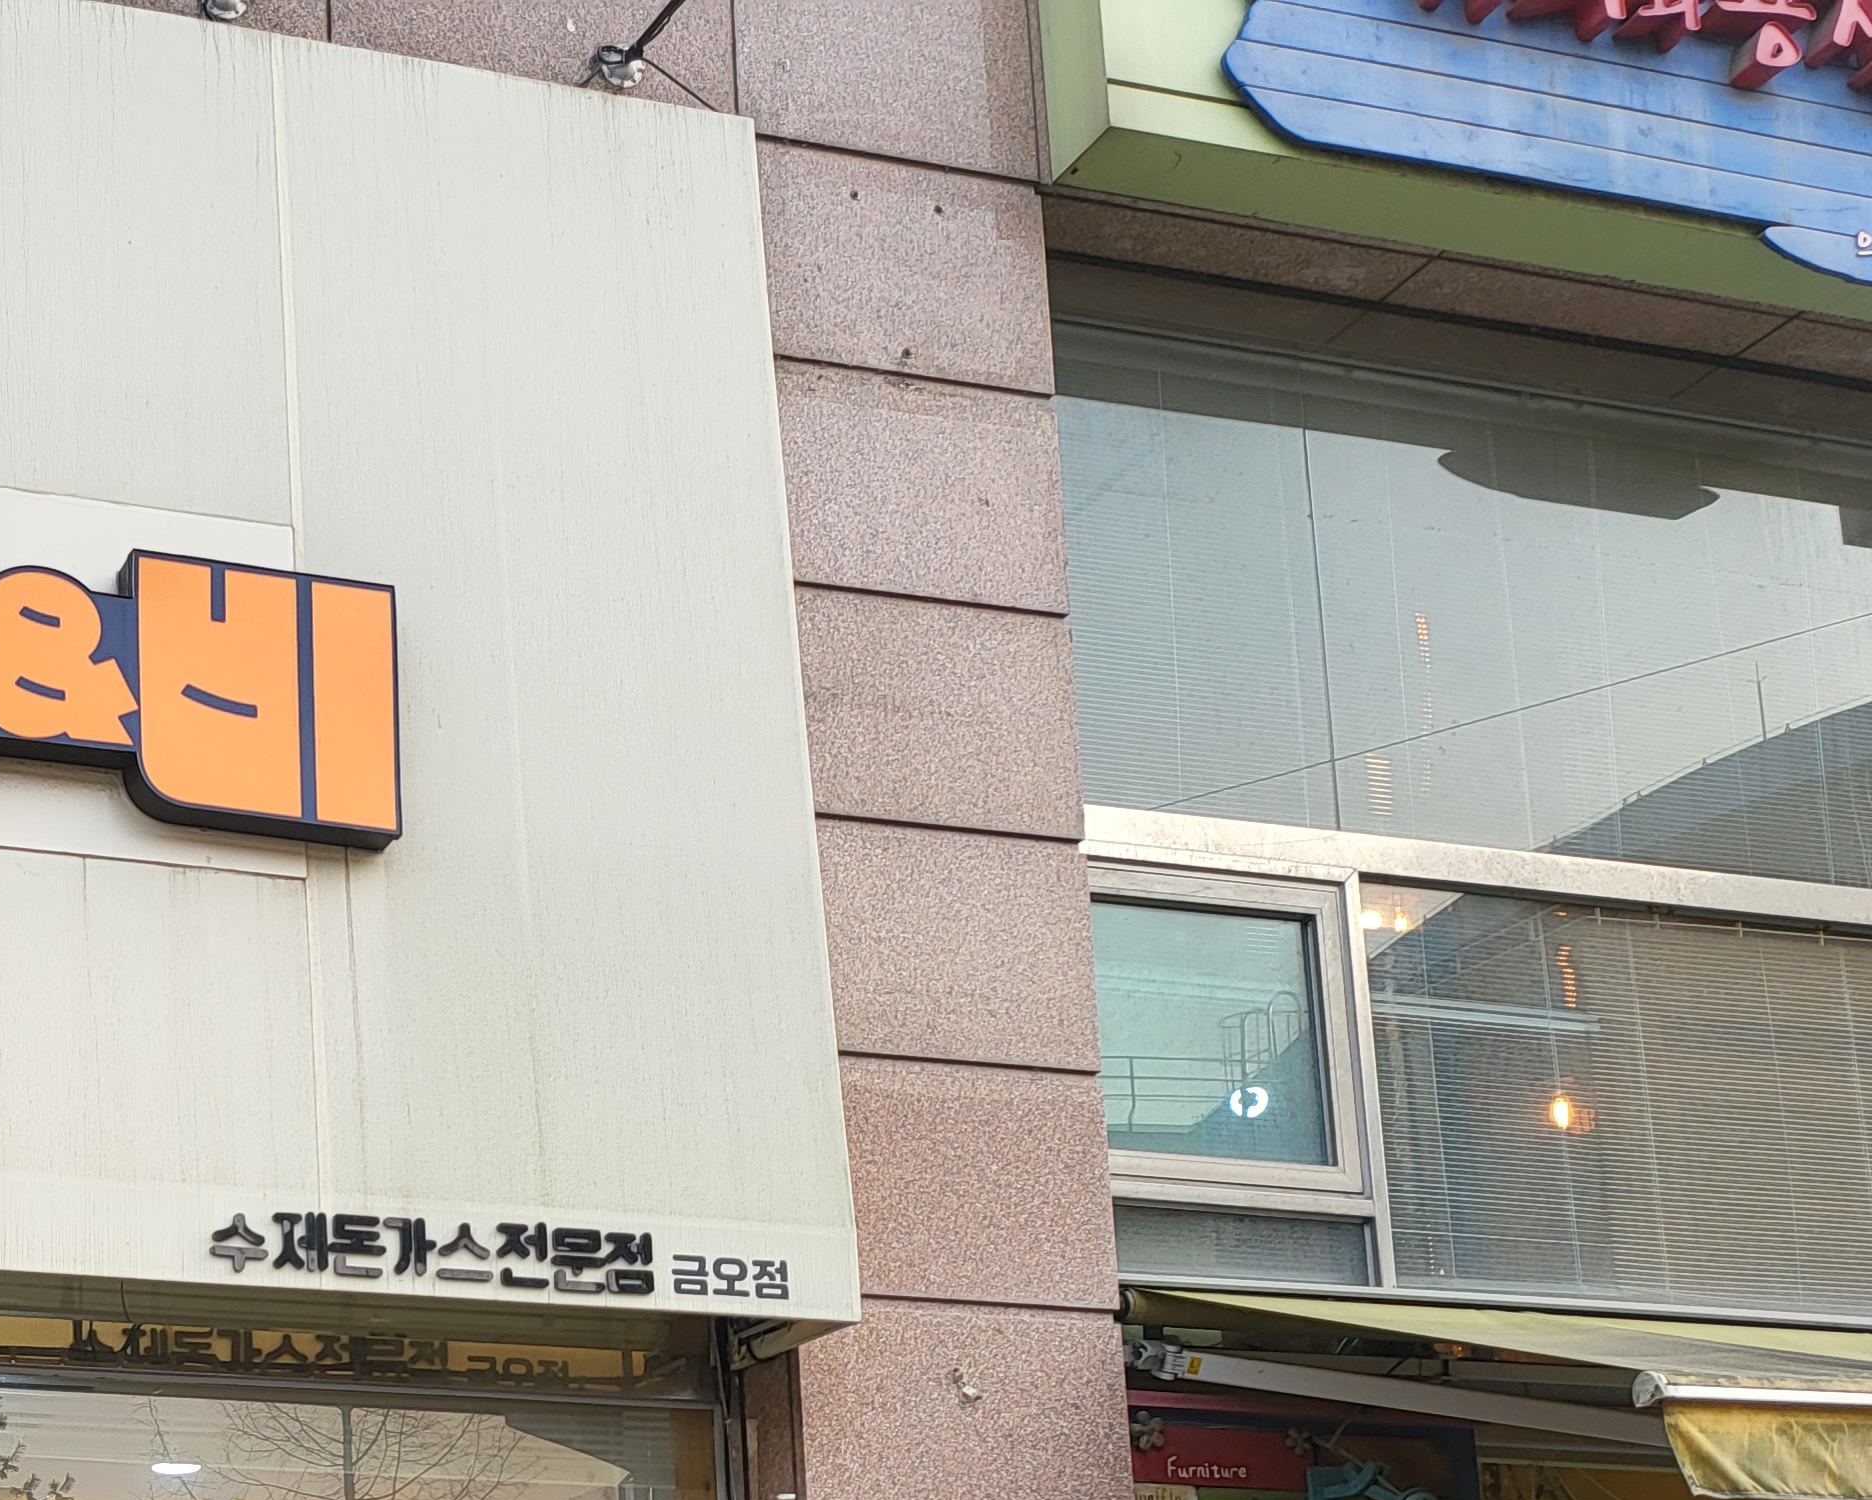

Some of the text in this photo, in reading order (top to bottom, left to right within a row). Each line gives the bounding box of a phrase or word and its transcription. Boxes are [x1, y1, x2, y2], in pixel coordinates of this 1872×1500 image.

[210, 1212, 790, 1300] 수제돈가스전문점 금오점
[1167, 1456, 1248, 1479] Furniture
